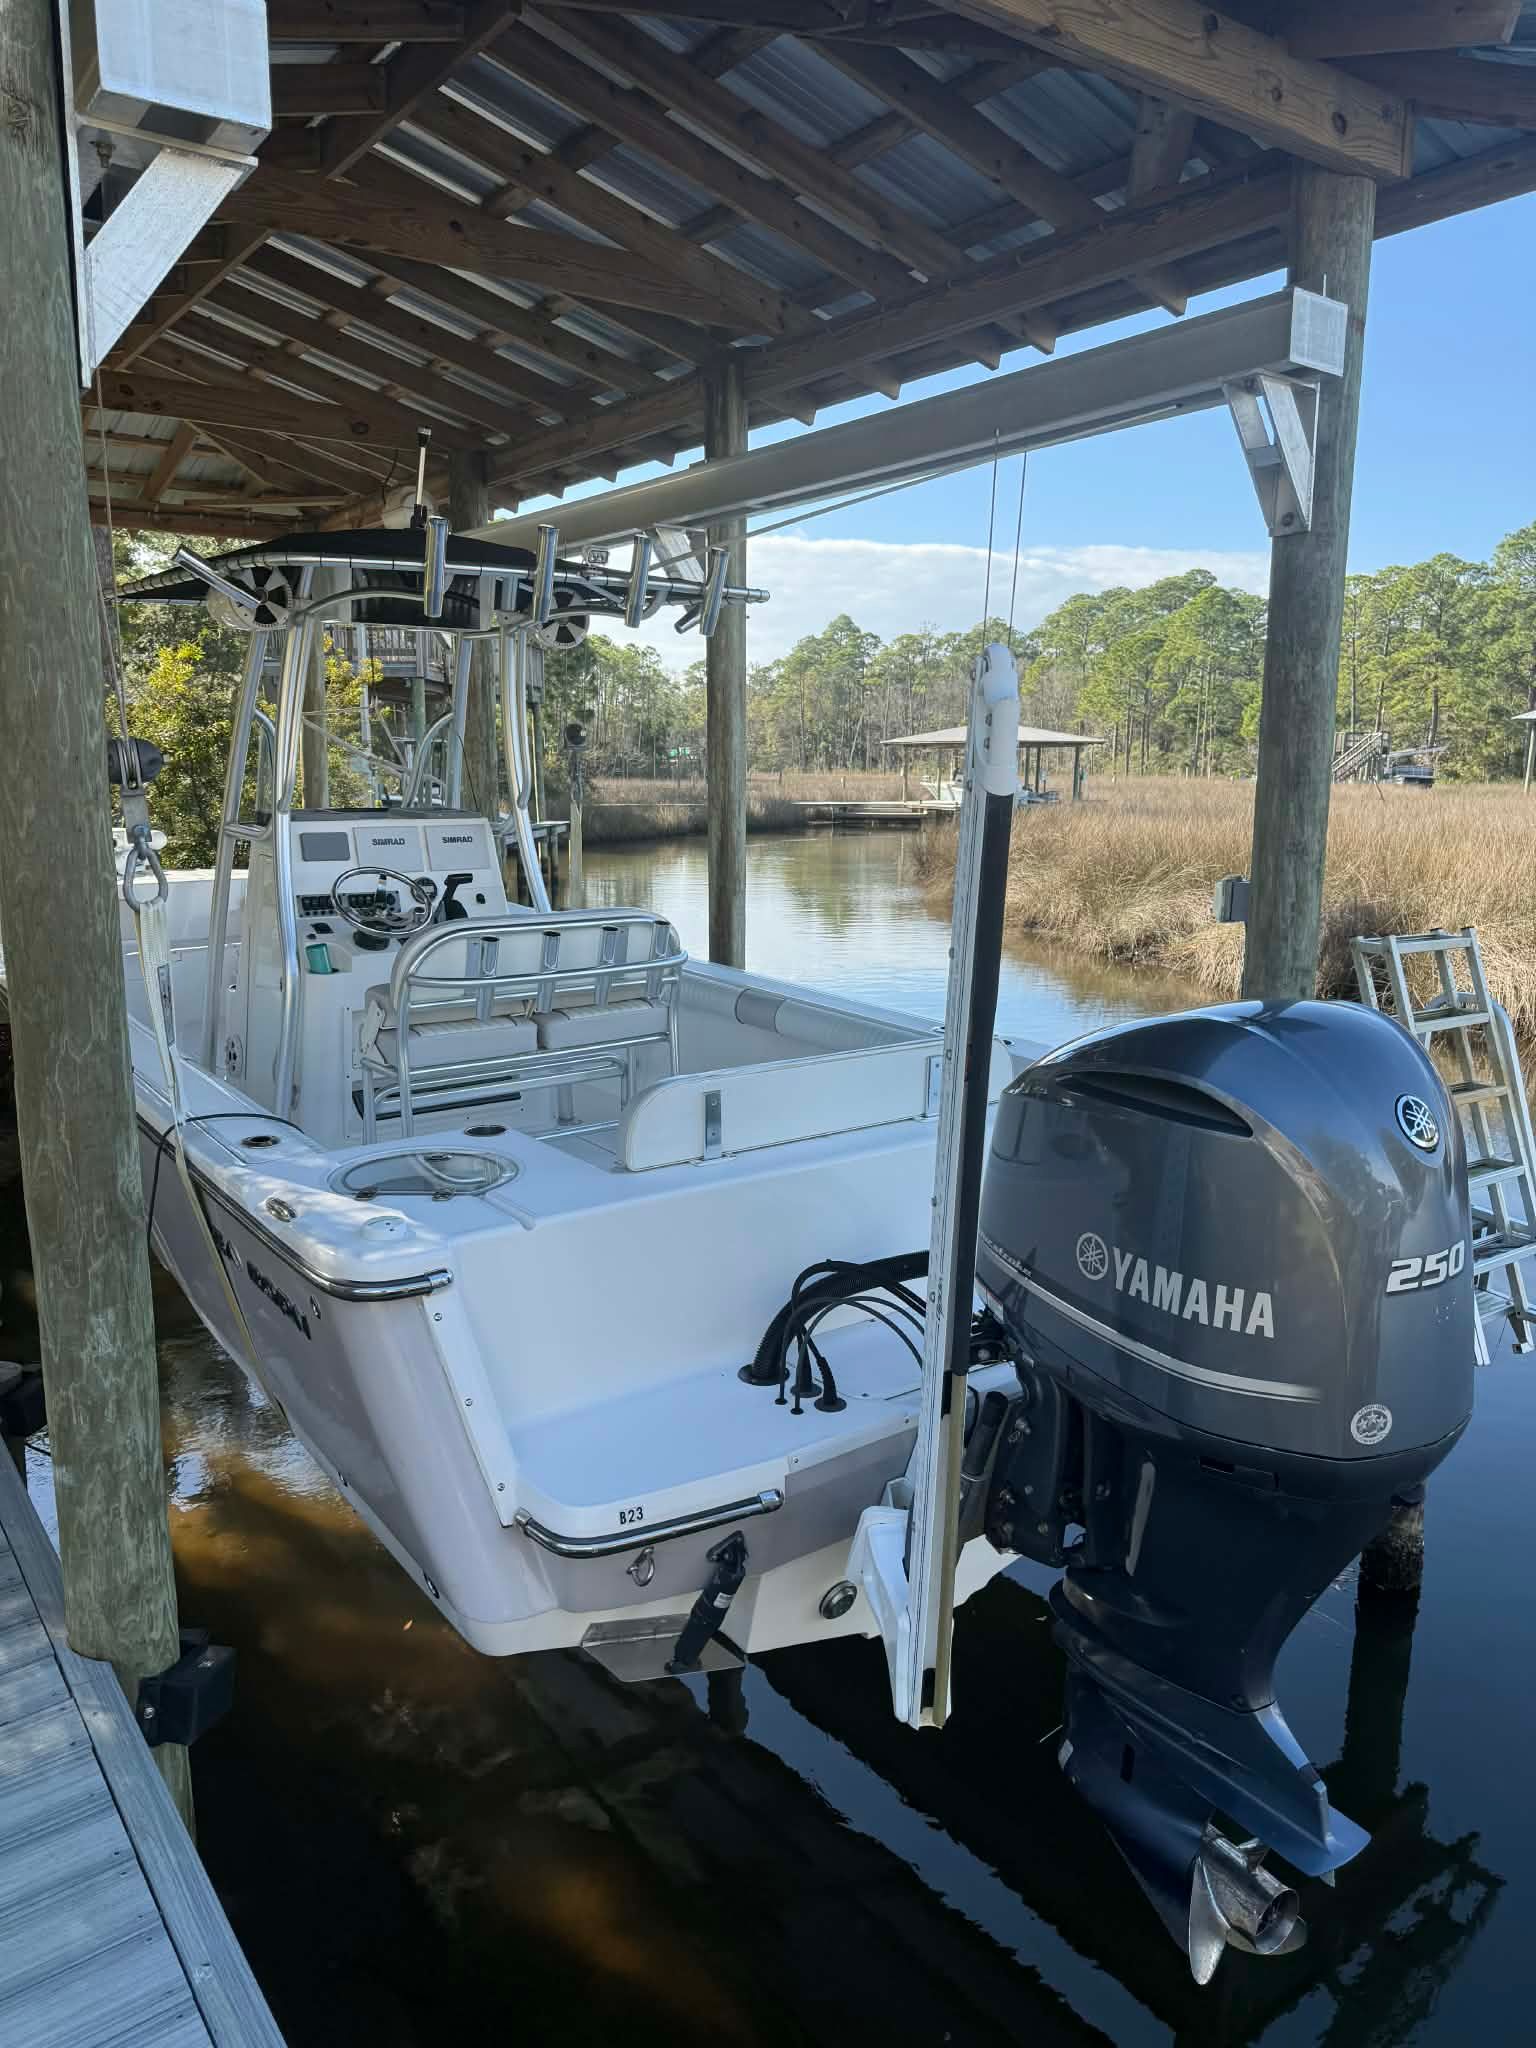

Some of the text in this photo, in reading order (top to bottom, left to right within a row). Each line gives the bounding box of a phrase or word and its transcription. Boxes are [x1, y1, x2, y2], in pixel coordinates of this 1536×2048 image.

[441, 835, 473, 844] SIMRAD
[1386, 1240, 1465, 1293] 250
[1112, 1246, 1275, 1339] YAMAHA
[619, 1506, 644, 1525] B23
